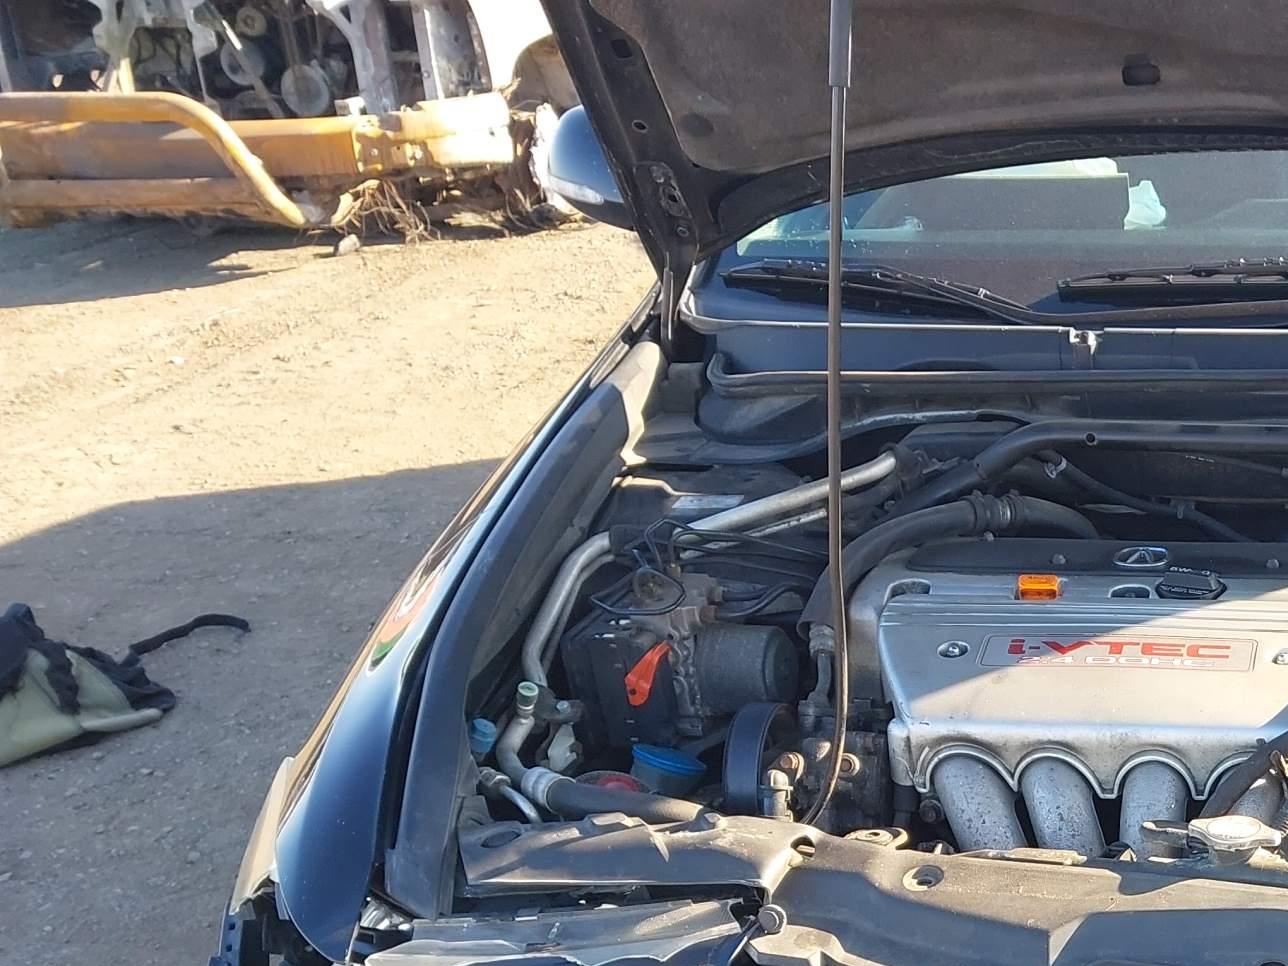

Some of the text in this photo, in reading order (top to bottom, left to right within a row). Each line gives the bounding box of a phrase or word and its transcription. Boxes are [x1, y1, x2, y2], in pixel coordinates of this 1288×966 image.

[1007, 638, 1231, 659] i-VTEC
[1017, 656, 1216, 668] 2.4 DOHC
